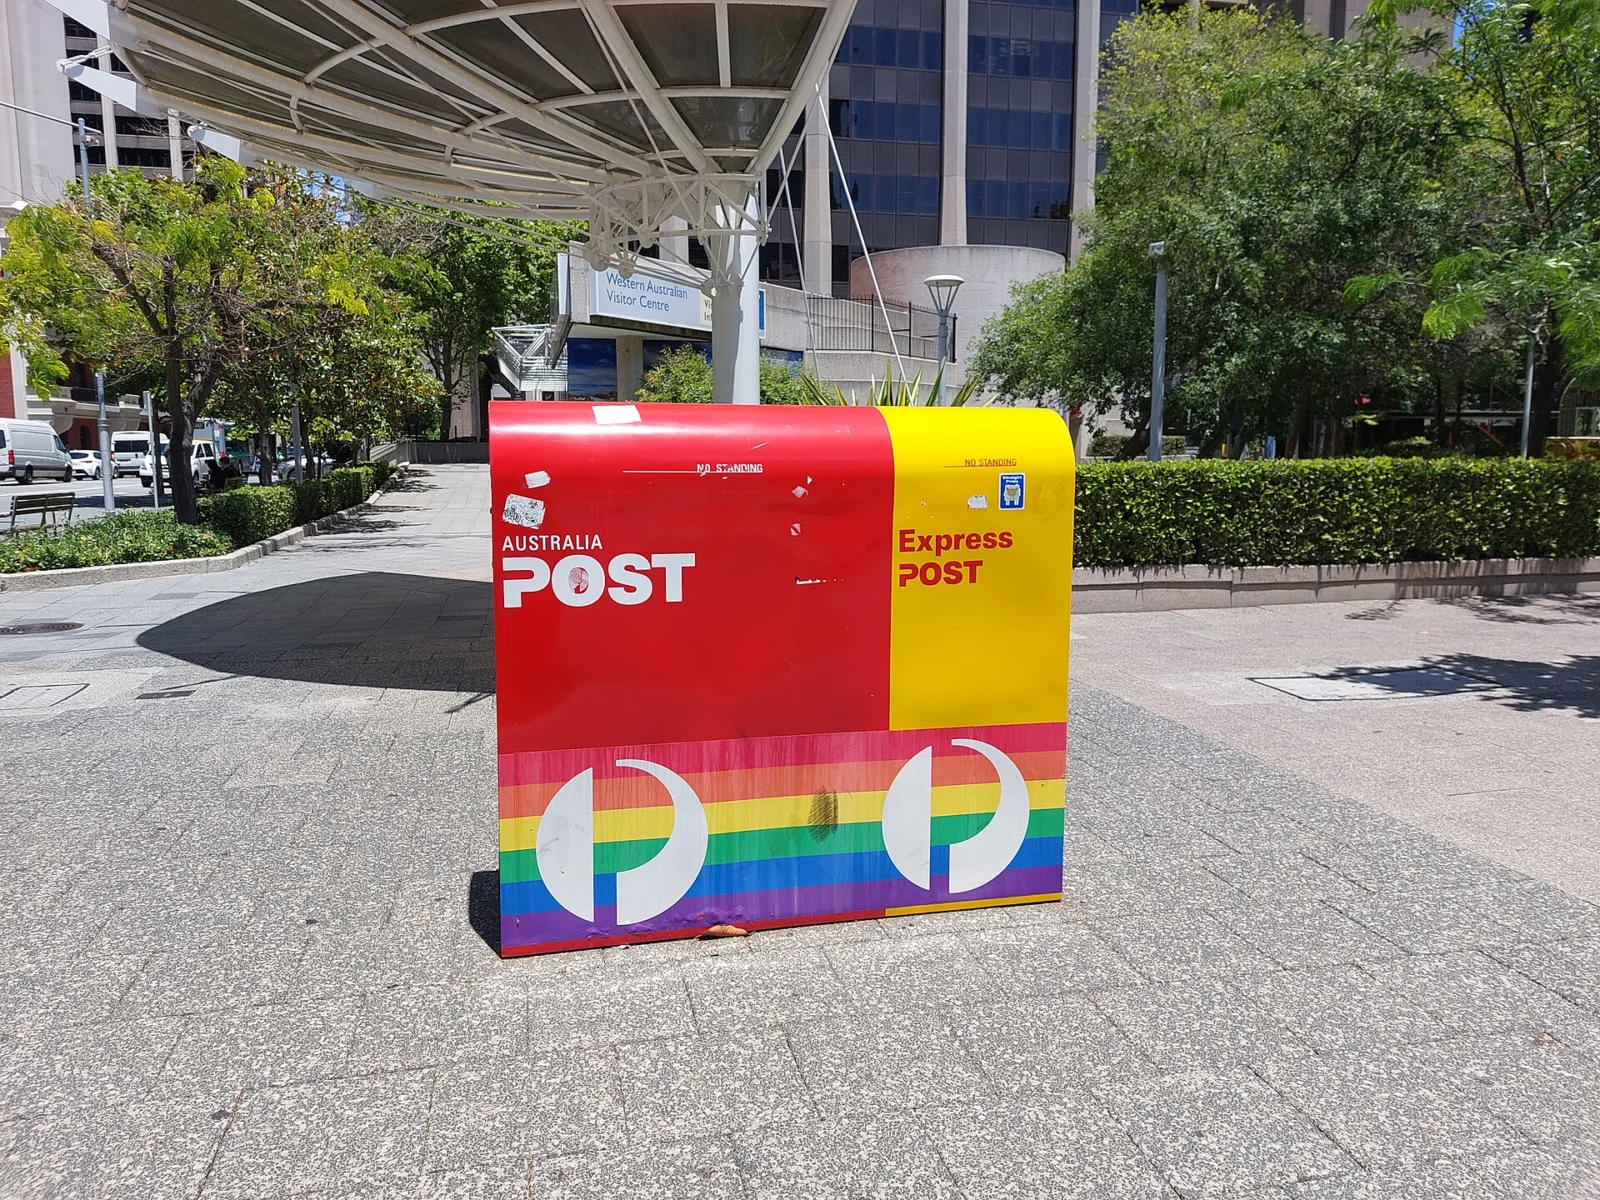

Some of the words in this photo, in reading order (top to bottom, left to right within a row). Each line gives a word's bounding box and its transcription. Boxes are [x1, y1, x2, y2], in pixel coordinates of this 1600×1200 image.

[606, 271, 645, 291] Western
[647, 280, 688, 299] Australian
[606, 288, 637, 306] Visitor
[639, 295, 670, 312] Centre
[697, 463, 711, 473] NO
[716, 463, 763, 473] STANDING
[965, 458, 976, 467] NO
[979, 458, 1017, 467] STANDING
[502, 534, 603, 552] AUSTRALIA
[899, 528, 1013, 557] Express
[502, 553, 696, 609] POST
[899, 560, 983, 588] POST
